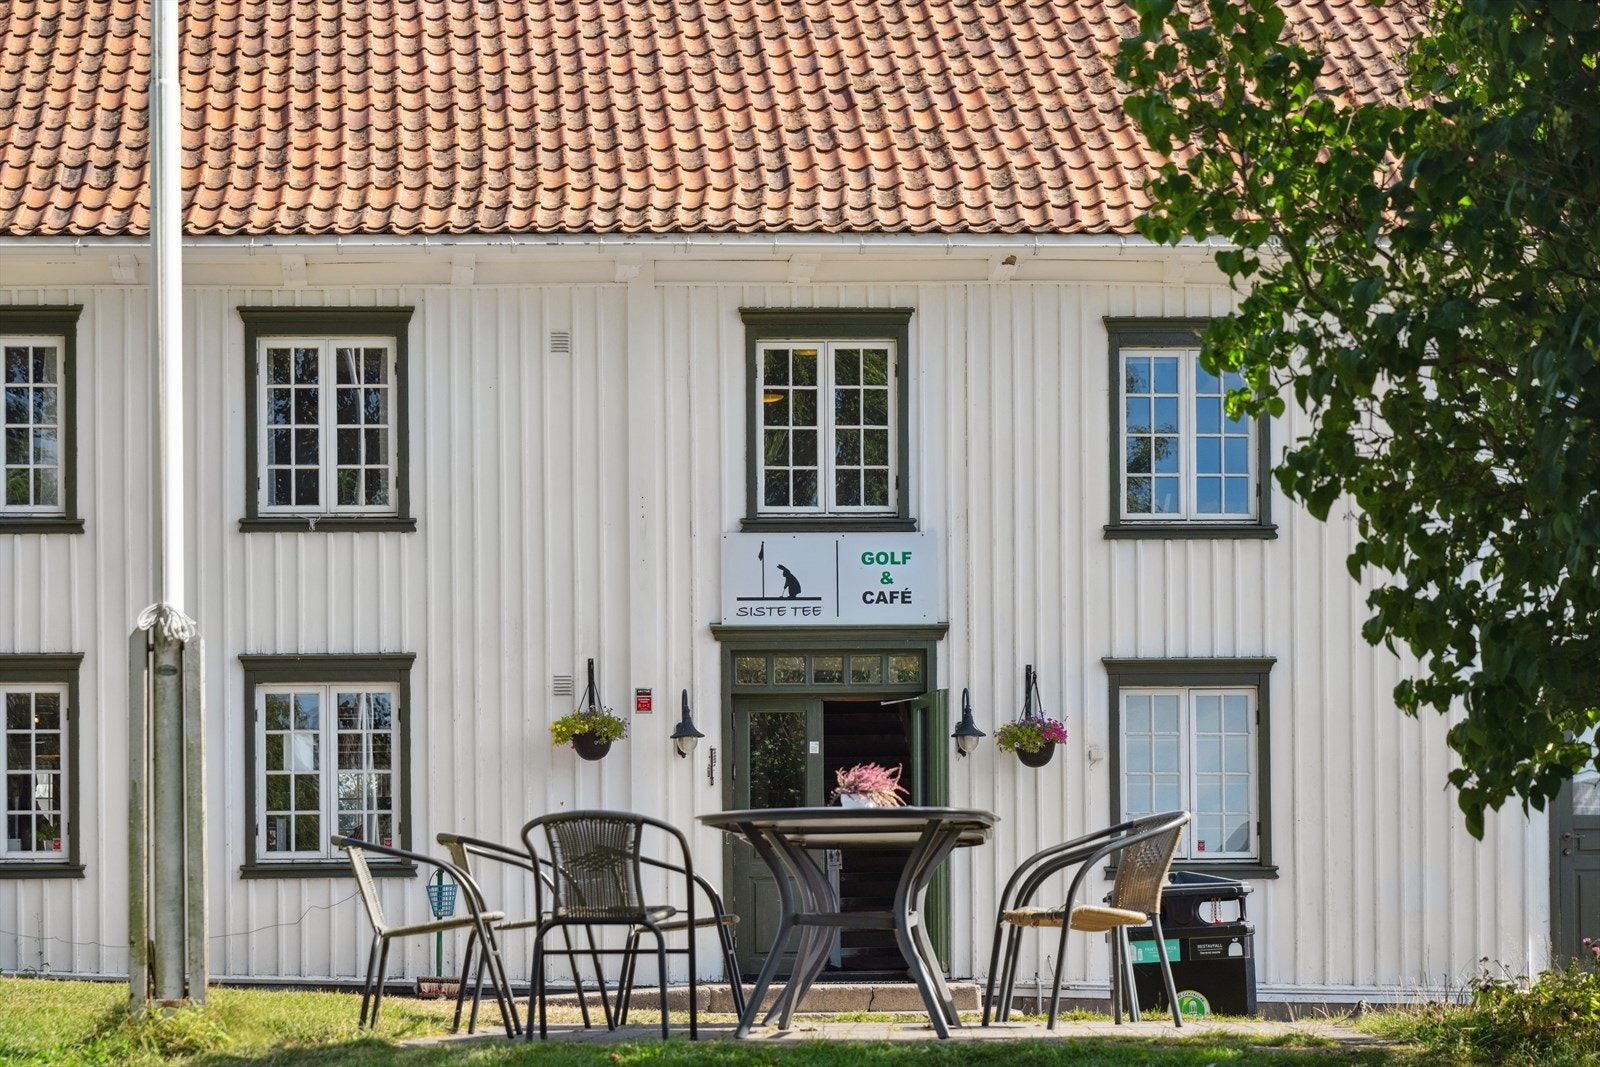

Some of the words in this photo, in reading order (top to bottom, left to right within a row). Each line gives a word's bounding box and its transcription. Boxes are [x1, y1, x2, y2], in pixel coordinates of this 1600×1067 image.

[860, 551, 912, 566] GOLF
[880, 571, 894, 585] &
[861, 587, 912, 605] CAFÉ
[736, 606, 787, 617] SISTE
[791, 606, 822, 617] TEE
